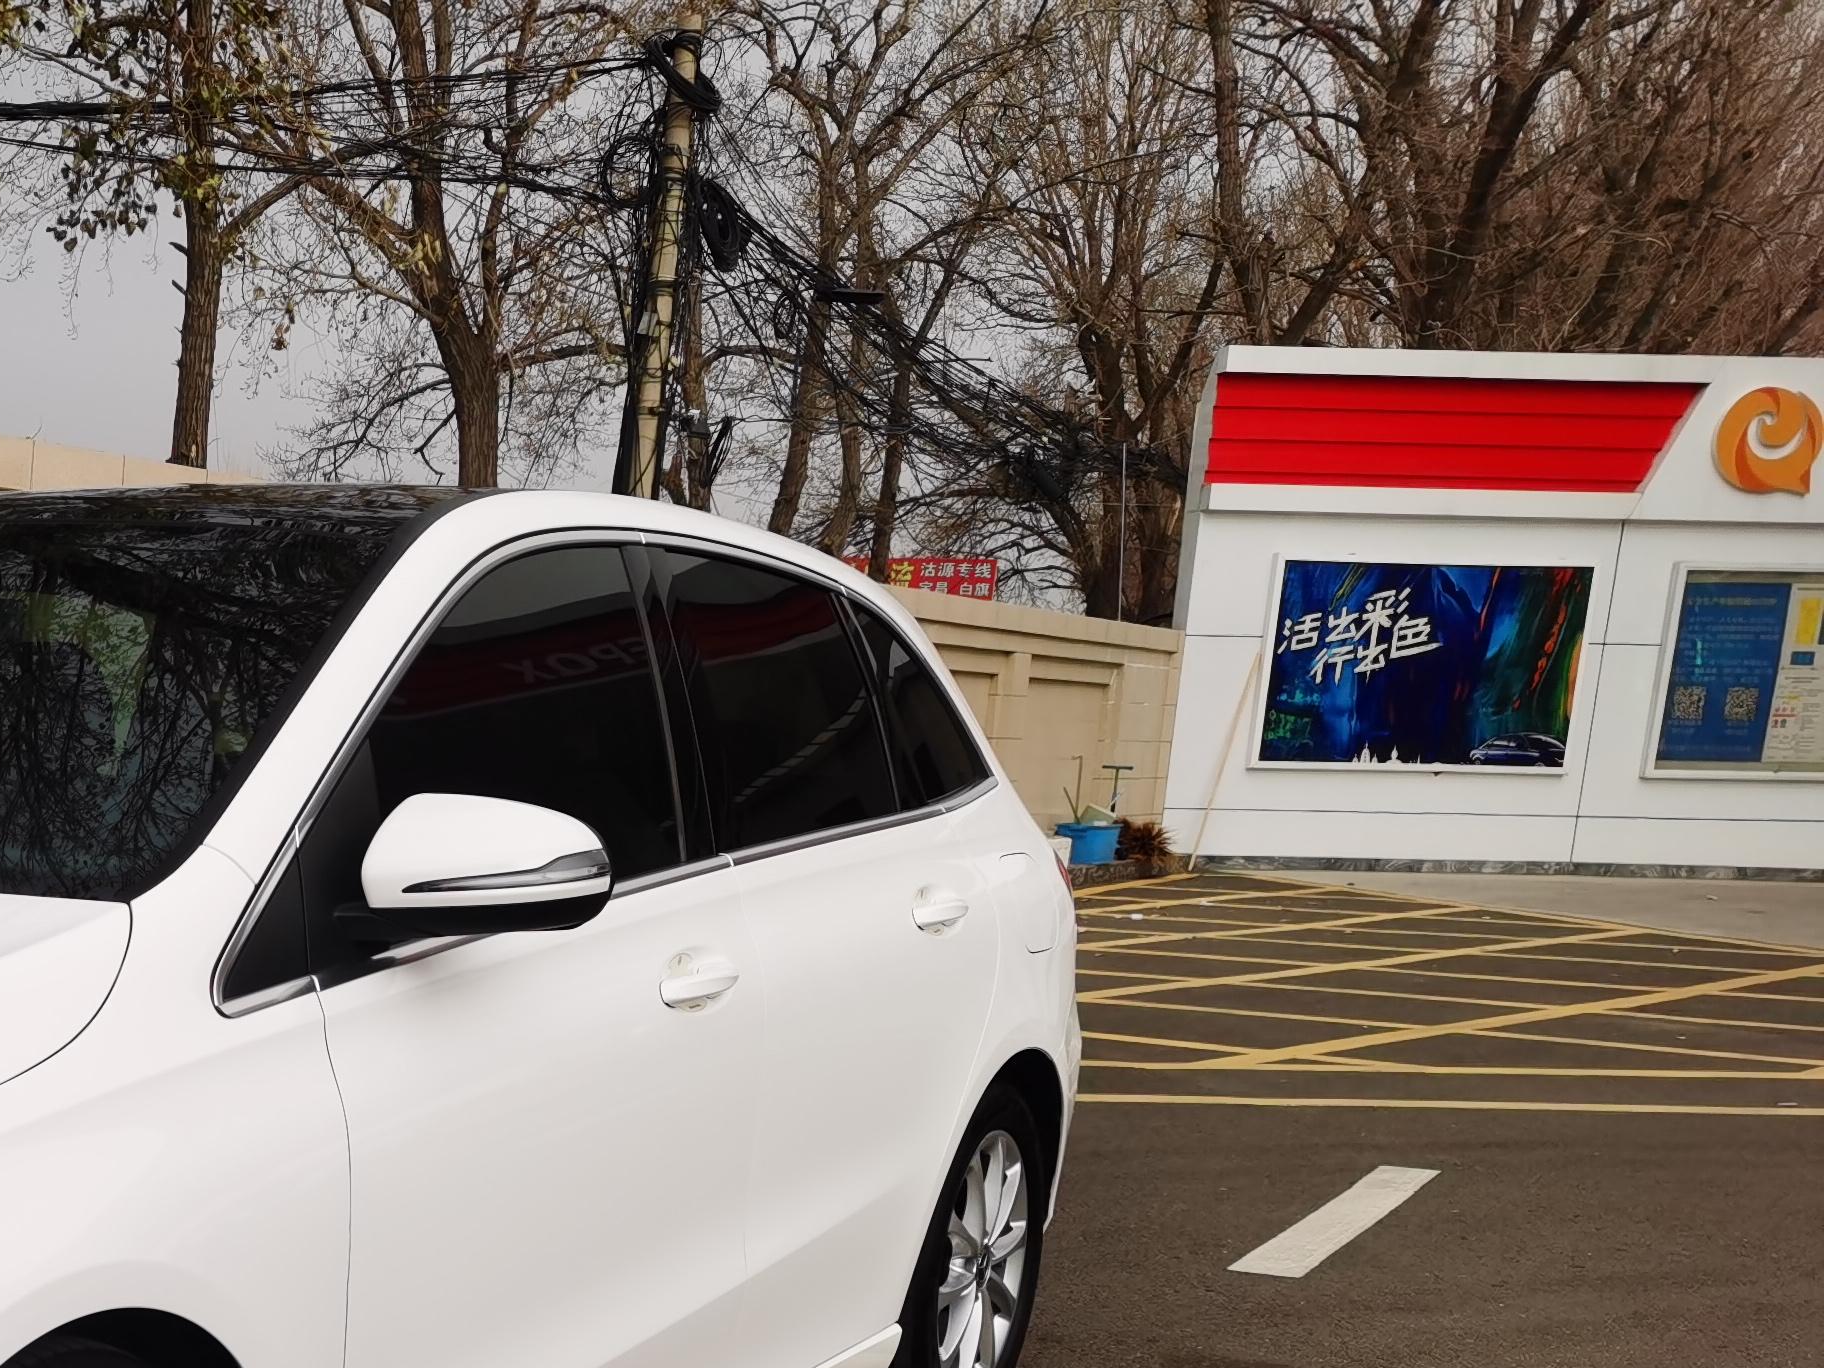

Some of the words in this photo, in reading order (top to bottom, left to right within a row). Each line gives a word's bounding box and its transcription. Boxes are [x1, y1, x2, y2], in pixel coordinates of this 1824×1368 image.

[920, 562, 992, 579] 沽源专线
[960, 582, 990, 597] 白旗
